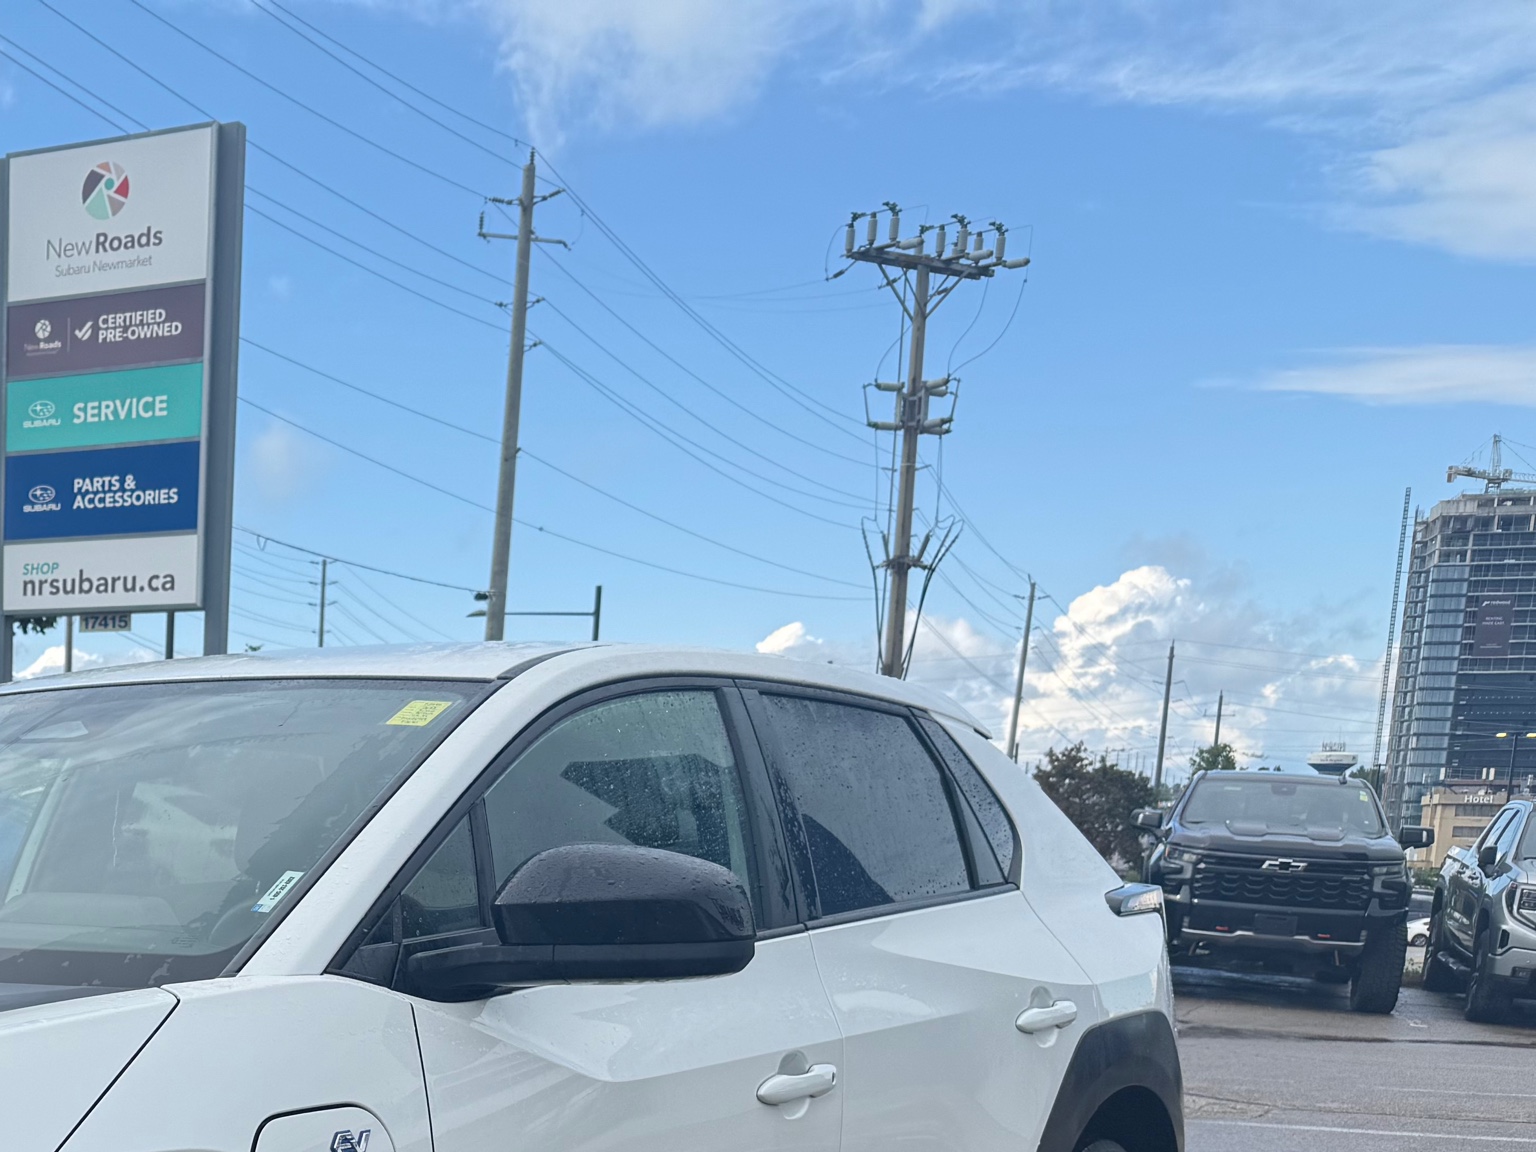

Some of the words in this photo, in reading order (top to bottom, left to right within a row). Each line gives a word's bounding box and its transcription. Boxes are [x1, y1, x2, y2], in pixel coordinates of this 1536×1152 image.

[54, 262, 91, 278] Subaru
[92, 255, 153, 274] Newmarket
[98, 309, 166, 328] CERTIFIED
[98, 322, 182, 343] PRE-OWNED
[72, 395, 169, 424] SERVICE
[22, 418, 61, 429] SUBARU
[73, 475, 120, 493] PARTS
[124, 474, 136, 490] &
[22, 502, 61, 513] SUBARU
[72, 488, 179, 510] ACCESSORIES
[22, 562, 60, 576] SHOP
[22, 569, 176, 597] nrsubaru.ca
[82, 614, 129, 630] 17415
[1464, 795, 1494, 804] Hotel
